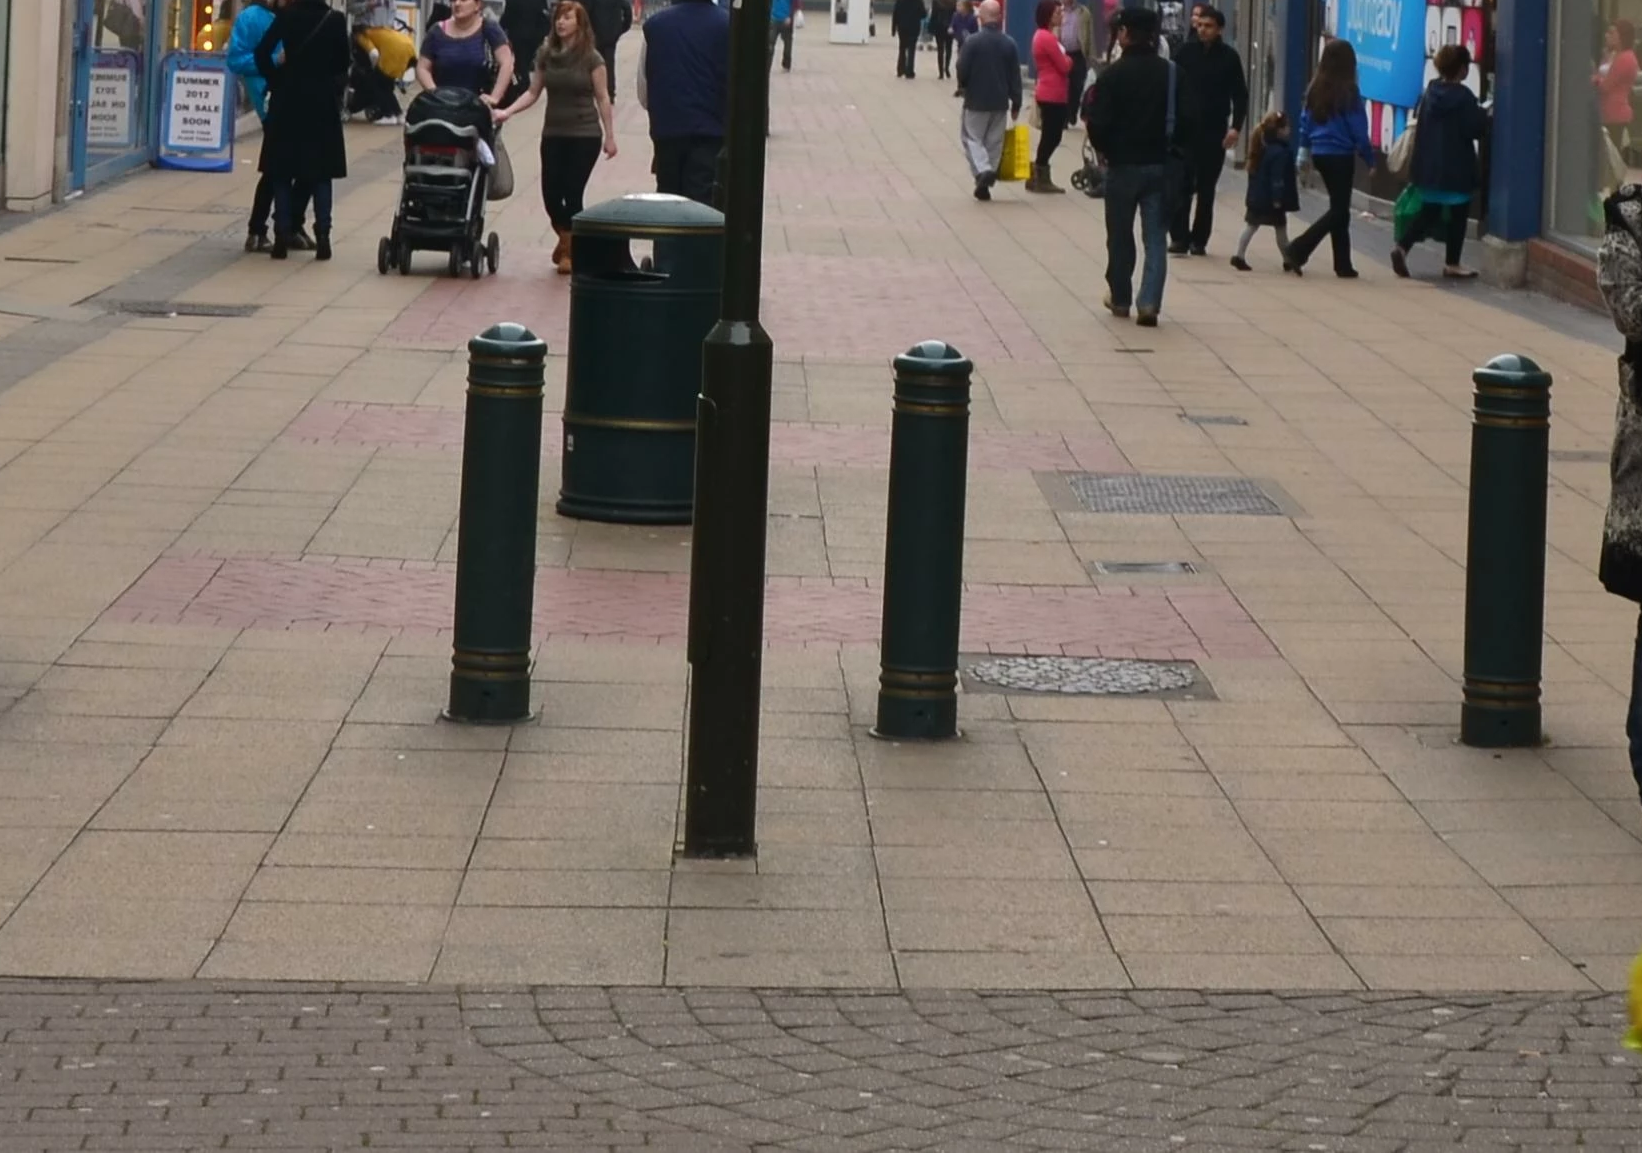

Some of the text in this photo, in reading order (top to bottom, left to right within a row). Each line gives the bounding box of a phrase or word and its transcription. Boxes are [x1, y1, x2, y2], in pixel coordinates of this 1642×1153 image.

[175, 76, 220, 87] SUMMER
[185, 90, 210, 100] 2012
[174, 104, 220, 114] ON SALE
[182, 117, 211, 127] SOON
